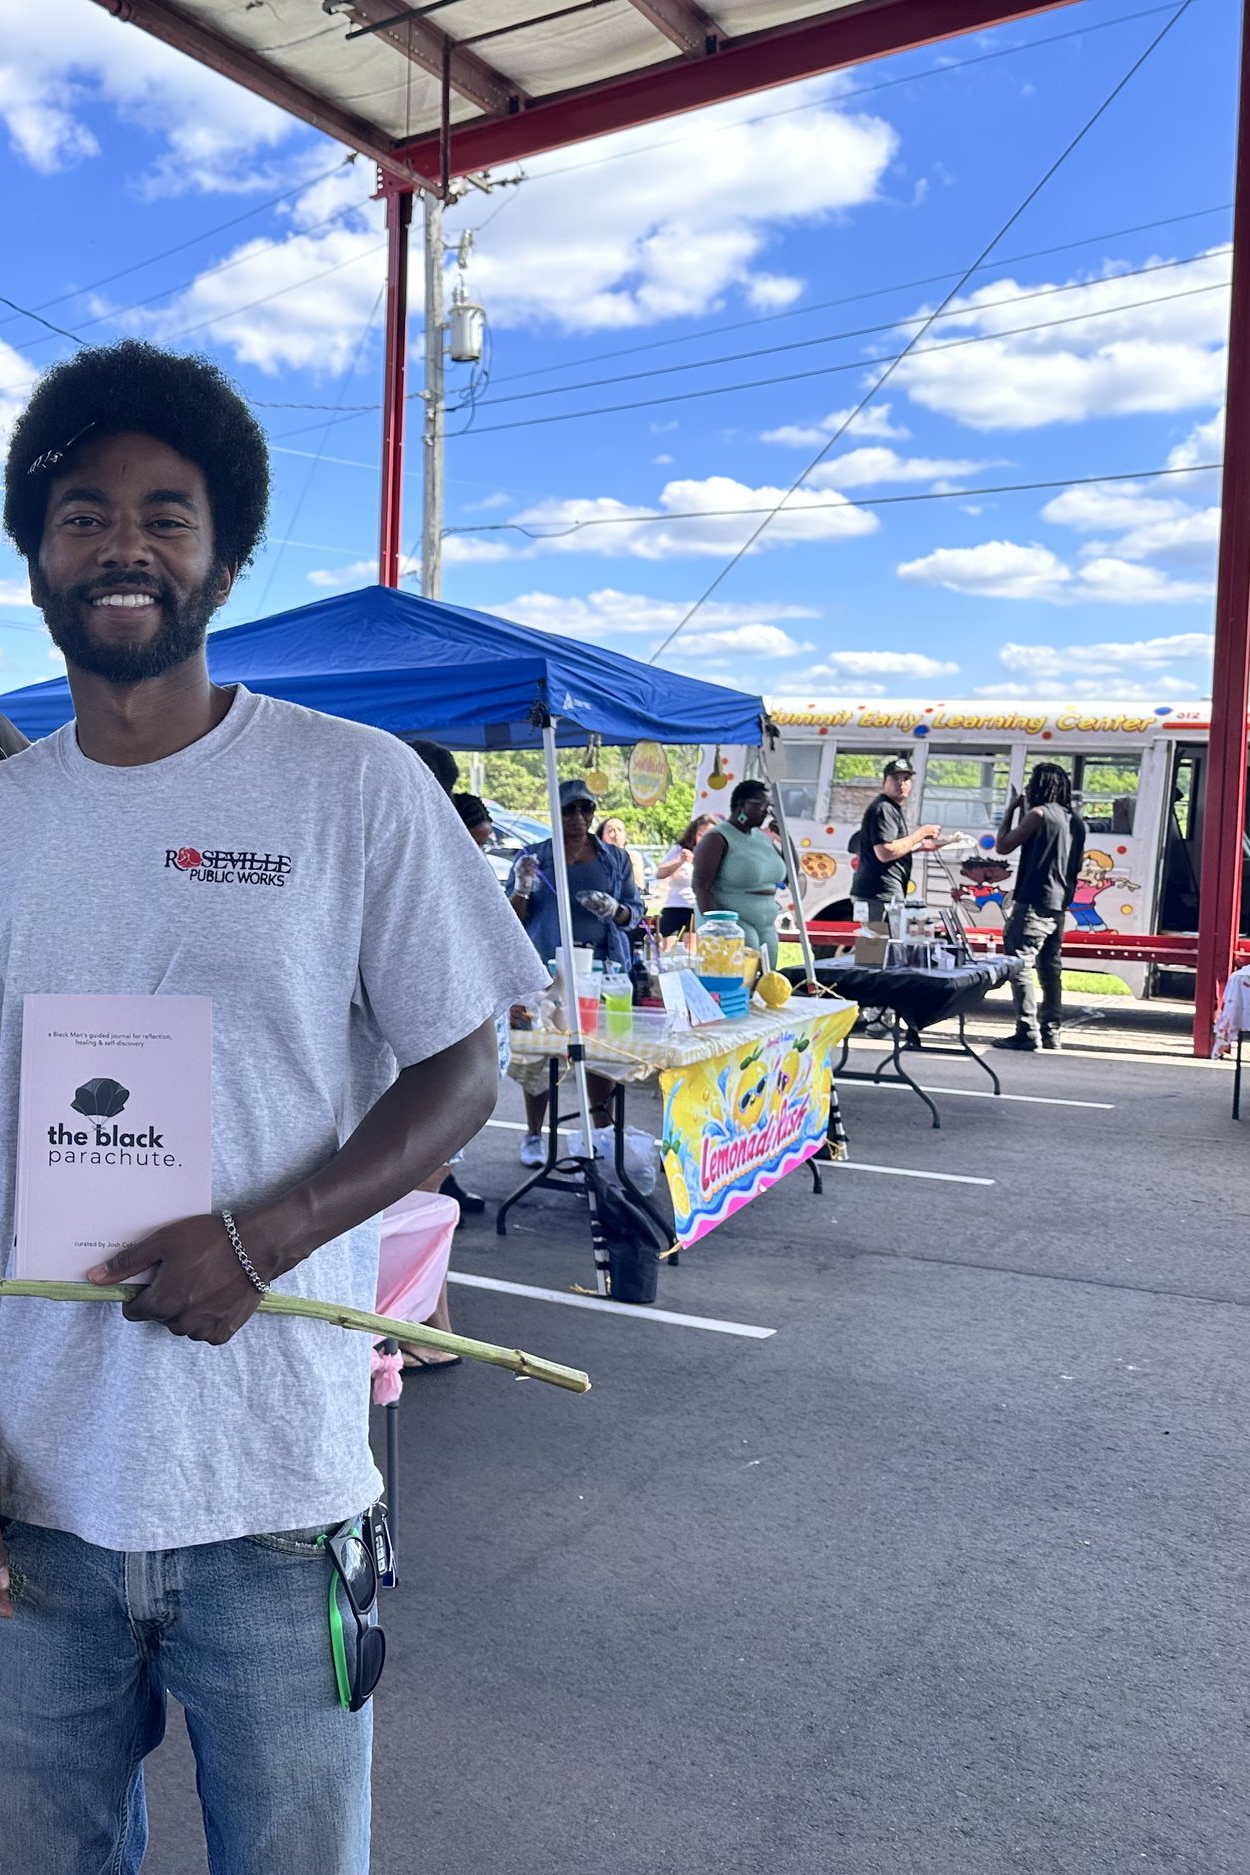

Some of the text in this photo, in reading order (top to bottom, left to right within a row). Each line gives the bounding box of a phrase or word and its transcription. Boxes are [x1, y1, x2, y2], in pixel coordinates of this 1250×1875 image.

[857, 709, 923, 733] Early
[932, 711, 1047, 736] Learning
[1055, 711, 1157, 732] Center
[164, 847, 292, 874] ROSEVILLE
[190, 869, 285, 887] PUBLIC WORKS
[70, 1031, 88, 1039] Man's
[89, 1032, 110, 1040] guided
[110, 1032, 132, 1040] journal
[75, 1039, 97, 1047] healing
[47, 1123, 165, 1149] the black
[701, 1092, 811, 1192] Lemonade Rush
[48, 1148, 182, 1167] parachute.
[98, 1241, 106, 1249] by
[107, 1241, 121, 1249] Josh
